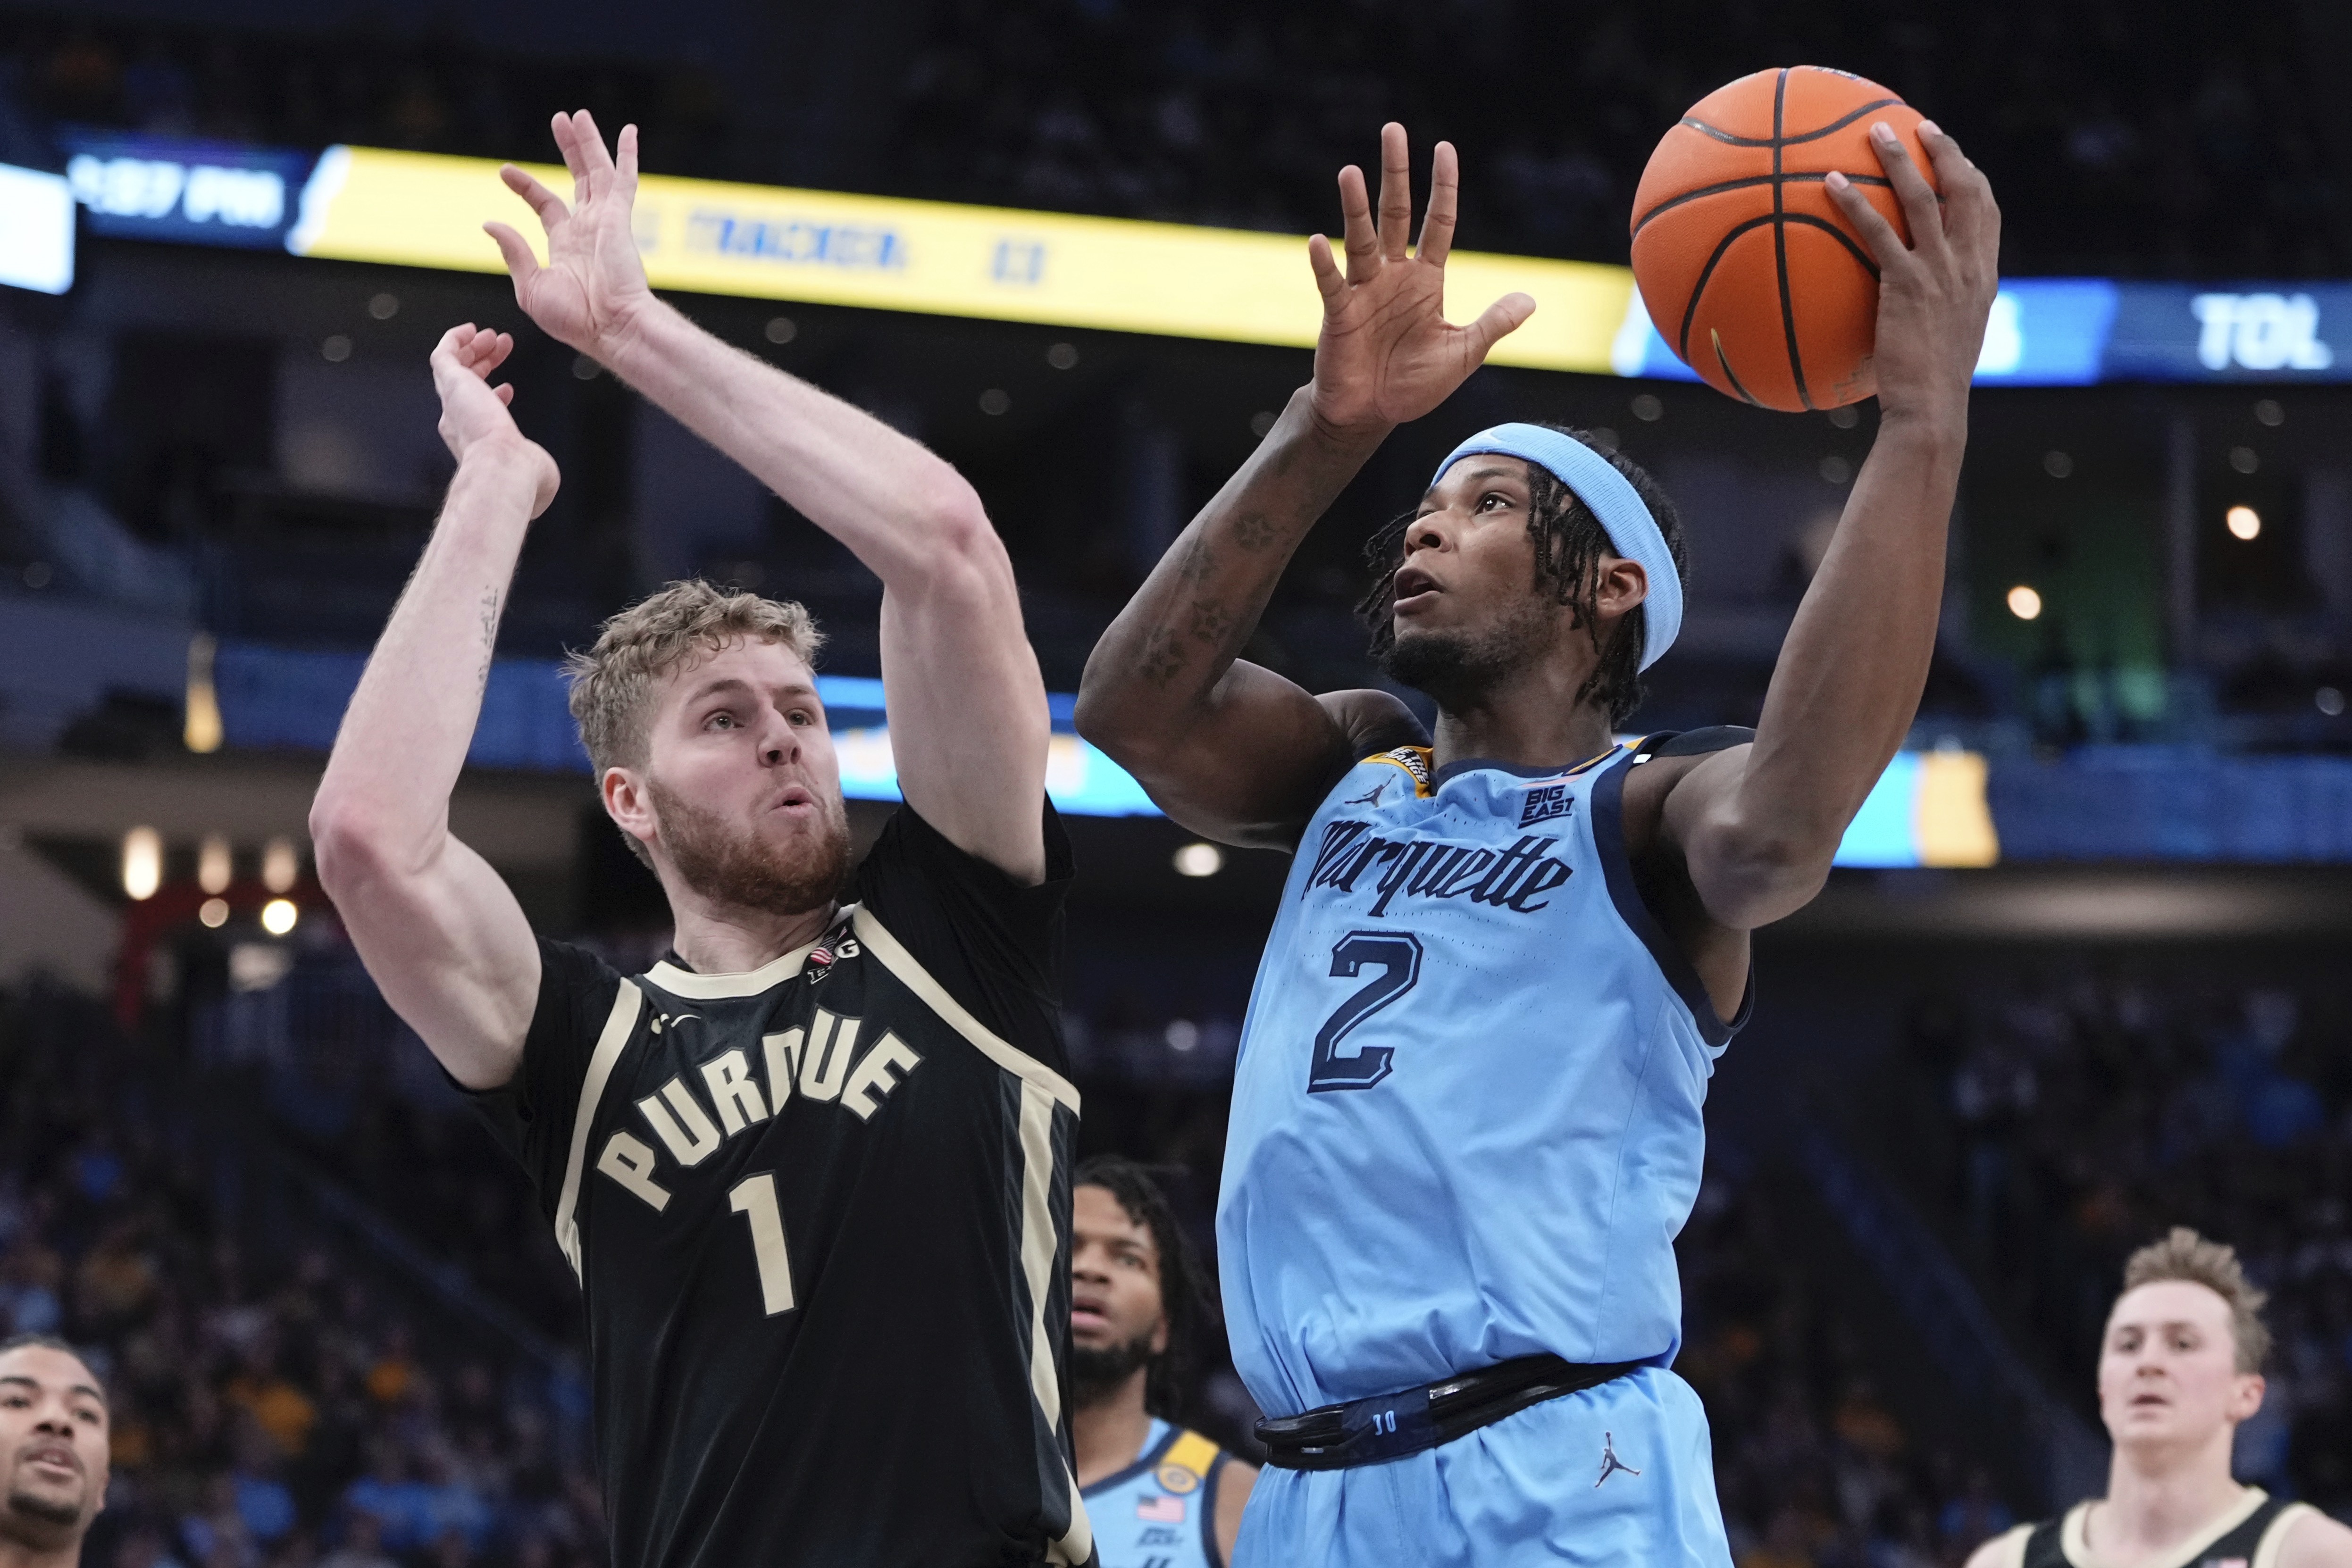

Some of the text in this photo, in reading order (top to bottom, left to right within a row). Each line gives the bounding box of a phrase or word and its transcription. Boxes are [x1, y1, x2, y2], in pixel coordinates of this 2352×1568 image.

[2190, 292, 2334, 371] TOL
[1411, 754, 1429, 781] THE
[1521, 797, 1575, 821] EAST
[1524, 784, 1566, 807] BIG
[1301, 820, 1574, 917] Marquette
[1306, 930, 1423, 1093] 2
[594, 1002, 926, 1212] PURDUE
[728, 1170, 798, 1319] 1
